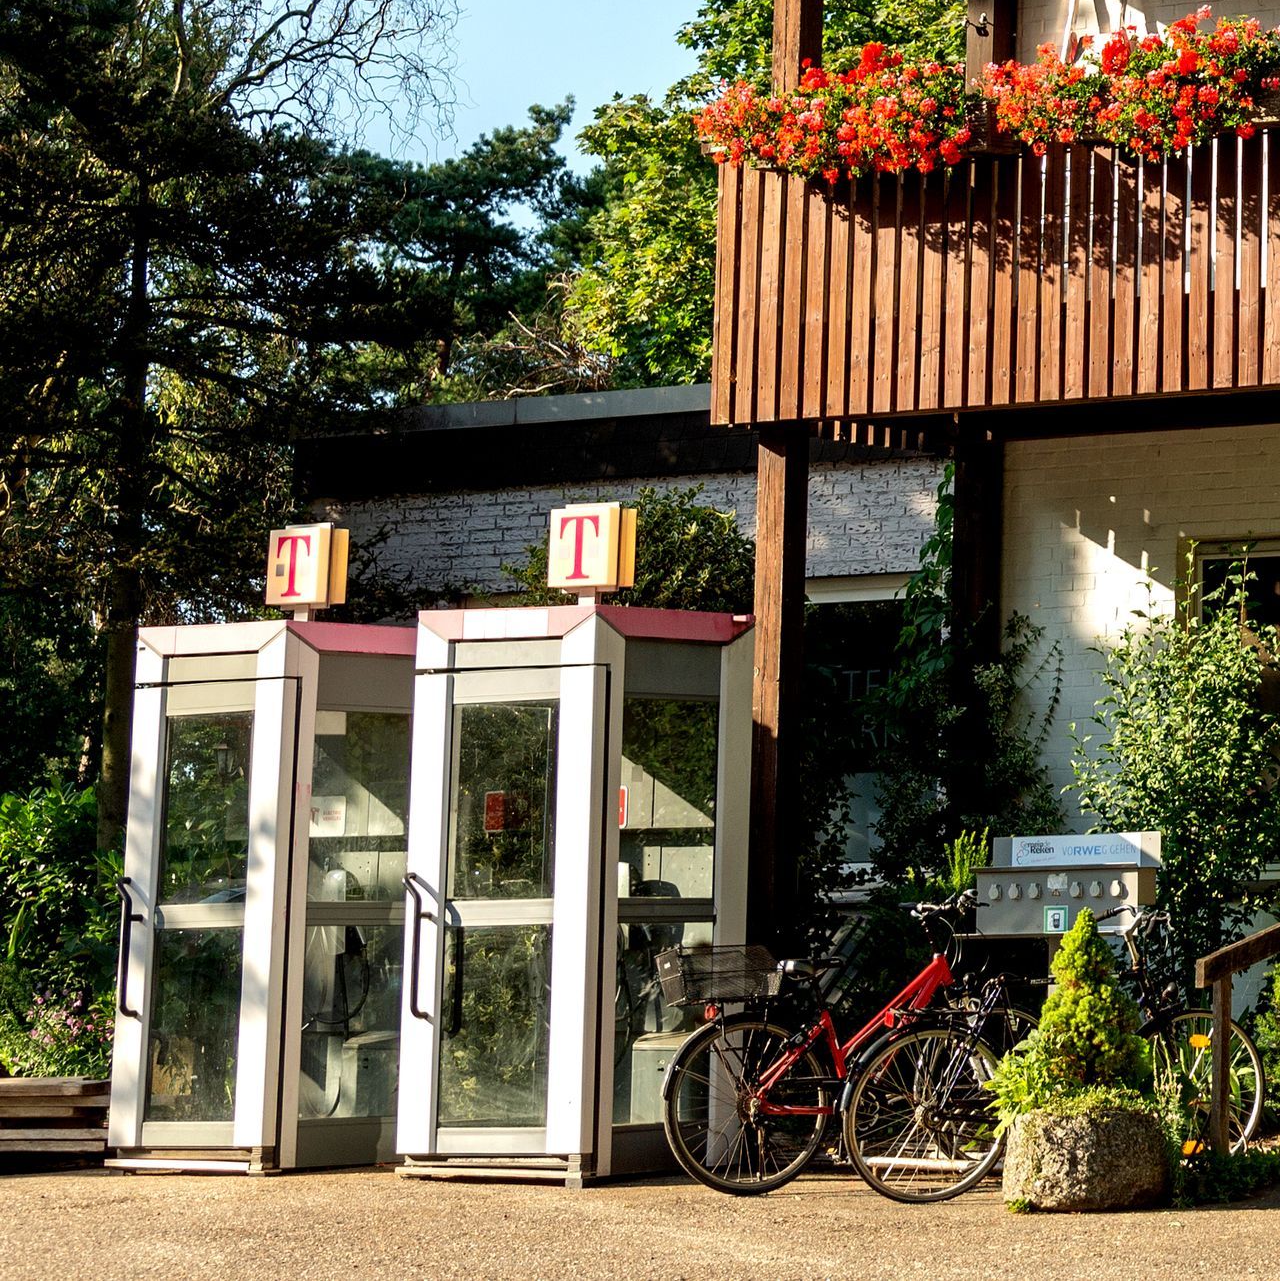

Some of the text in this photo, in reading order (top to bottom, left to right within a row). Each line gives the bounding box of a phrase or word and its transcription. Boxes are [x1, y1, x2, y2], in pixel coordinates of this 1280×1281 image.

[560, 515, 600, 579] T
[276, 535, 311, 597] T
[1029, 845, 1055, 855] Reken
[1062, 843, 1137, 856] VORWEG GEHEN
